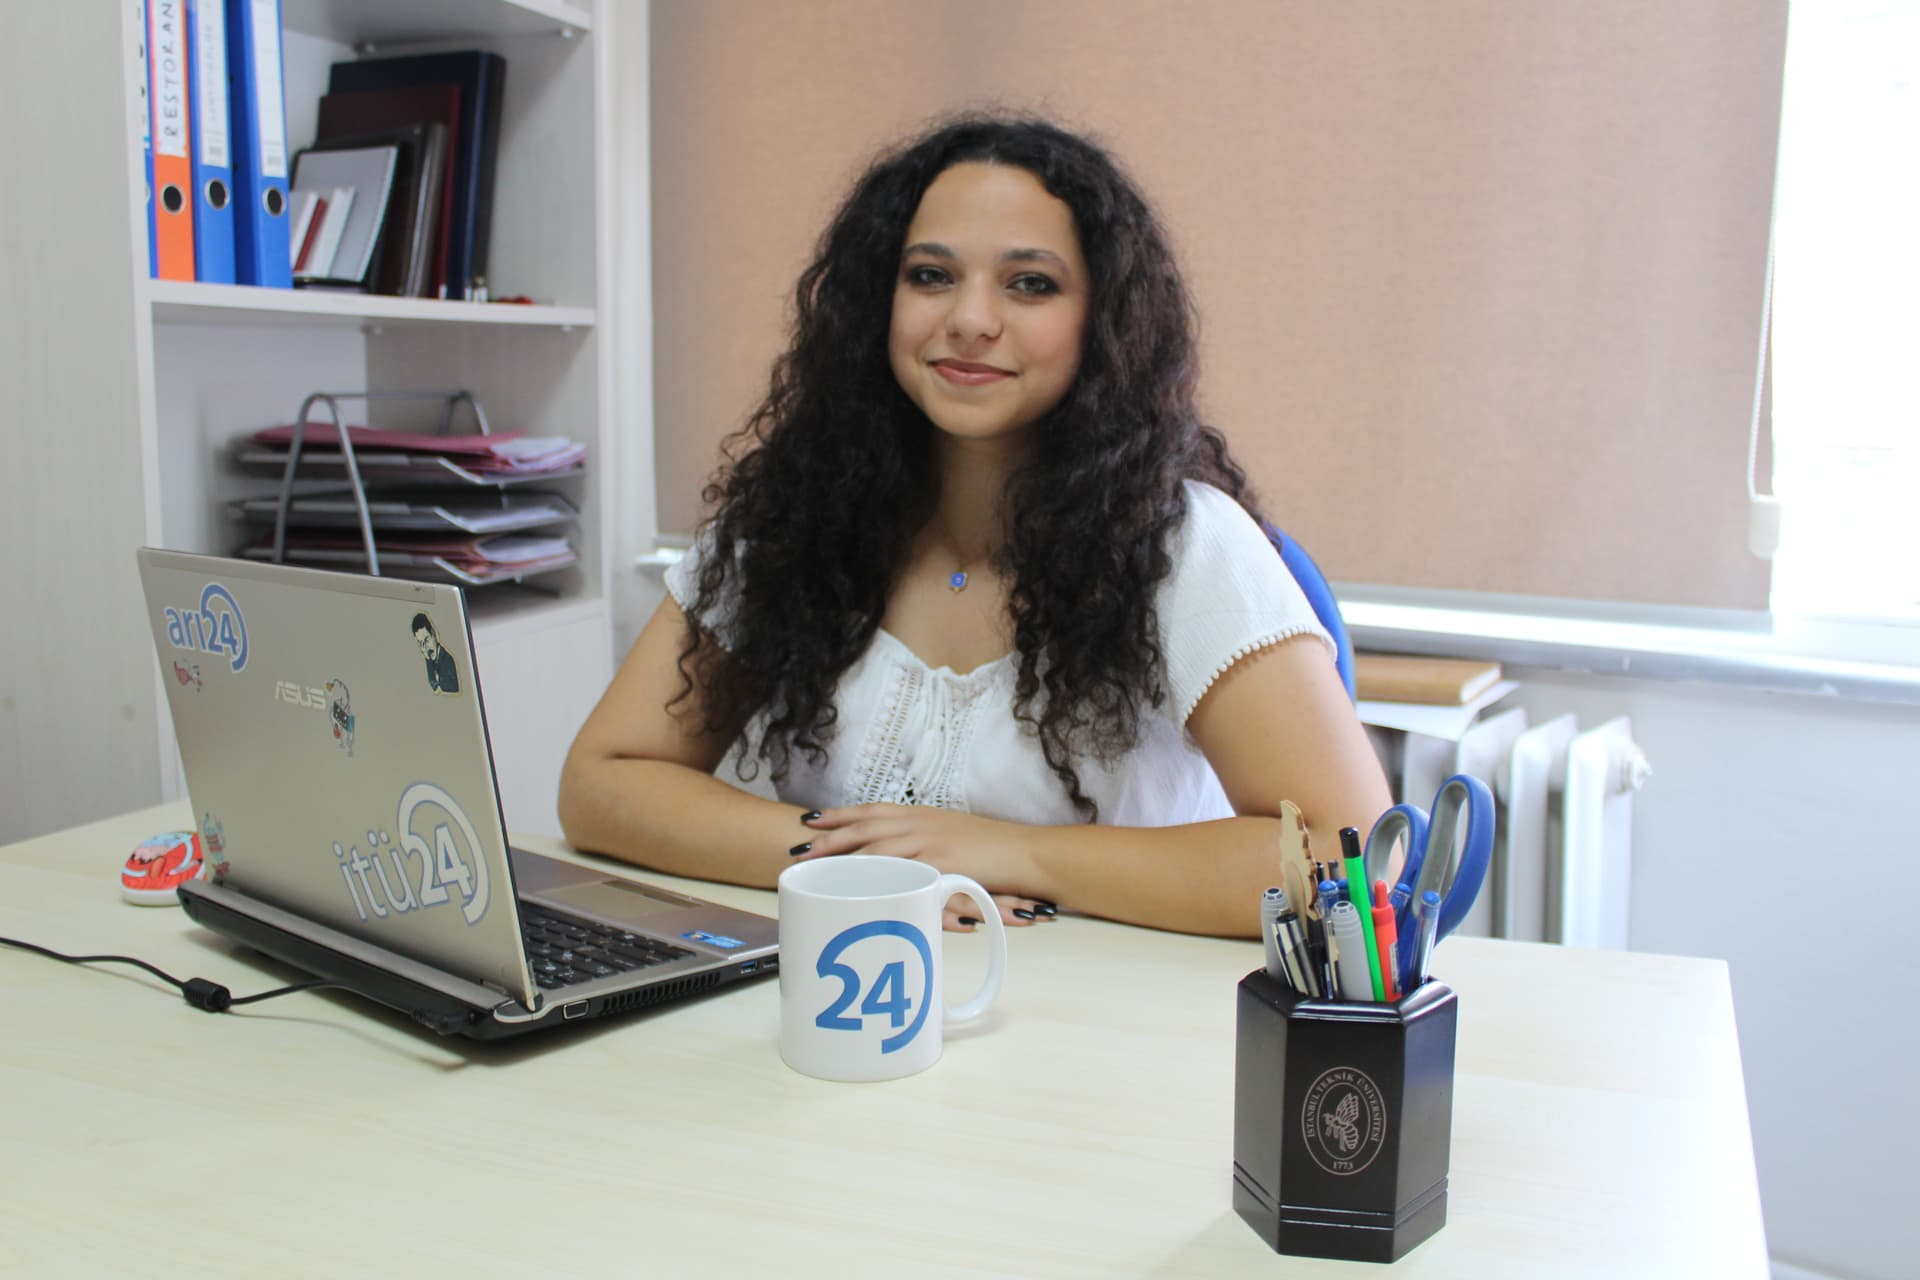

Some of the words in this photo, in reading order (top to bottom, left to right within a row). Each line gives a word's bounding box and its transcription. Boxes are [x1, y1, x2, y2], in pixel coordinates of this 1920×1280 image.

[161, 3, 179, 137] RESTORAN
[274, 680, 328, 711] ASUS
[332, 781, 490, 925] itü24
[815, 919, 934, 1055] 24
